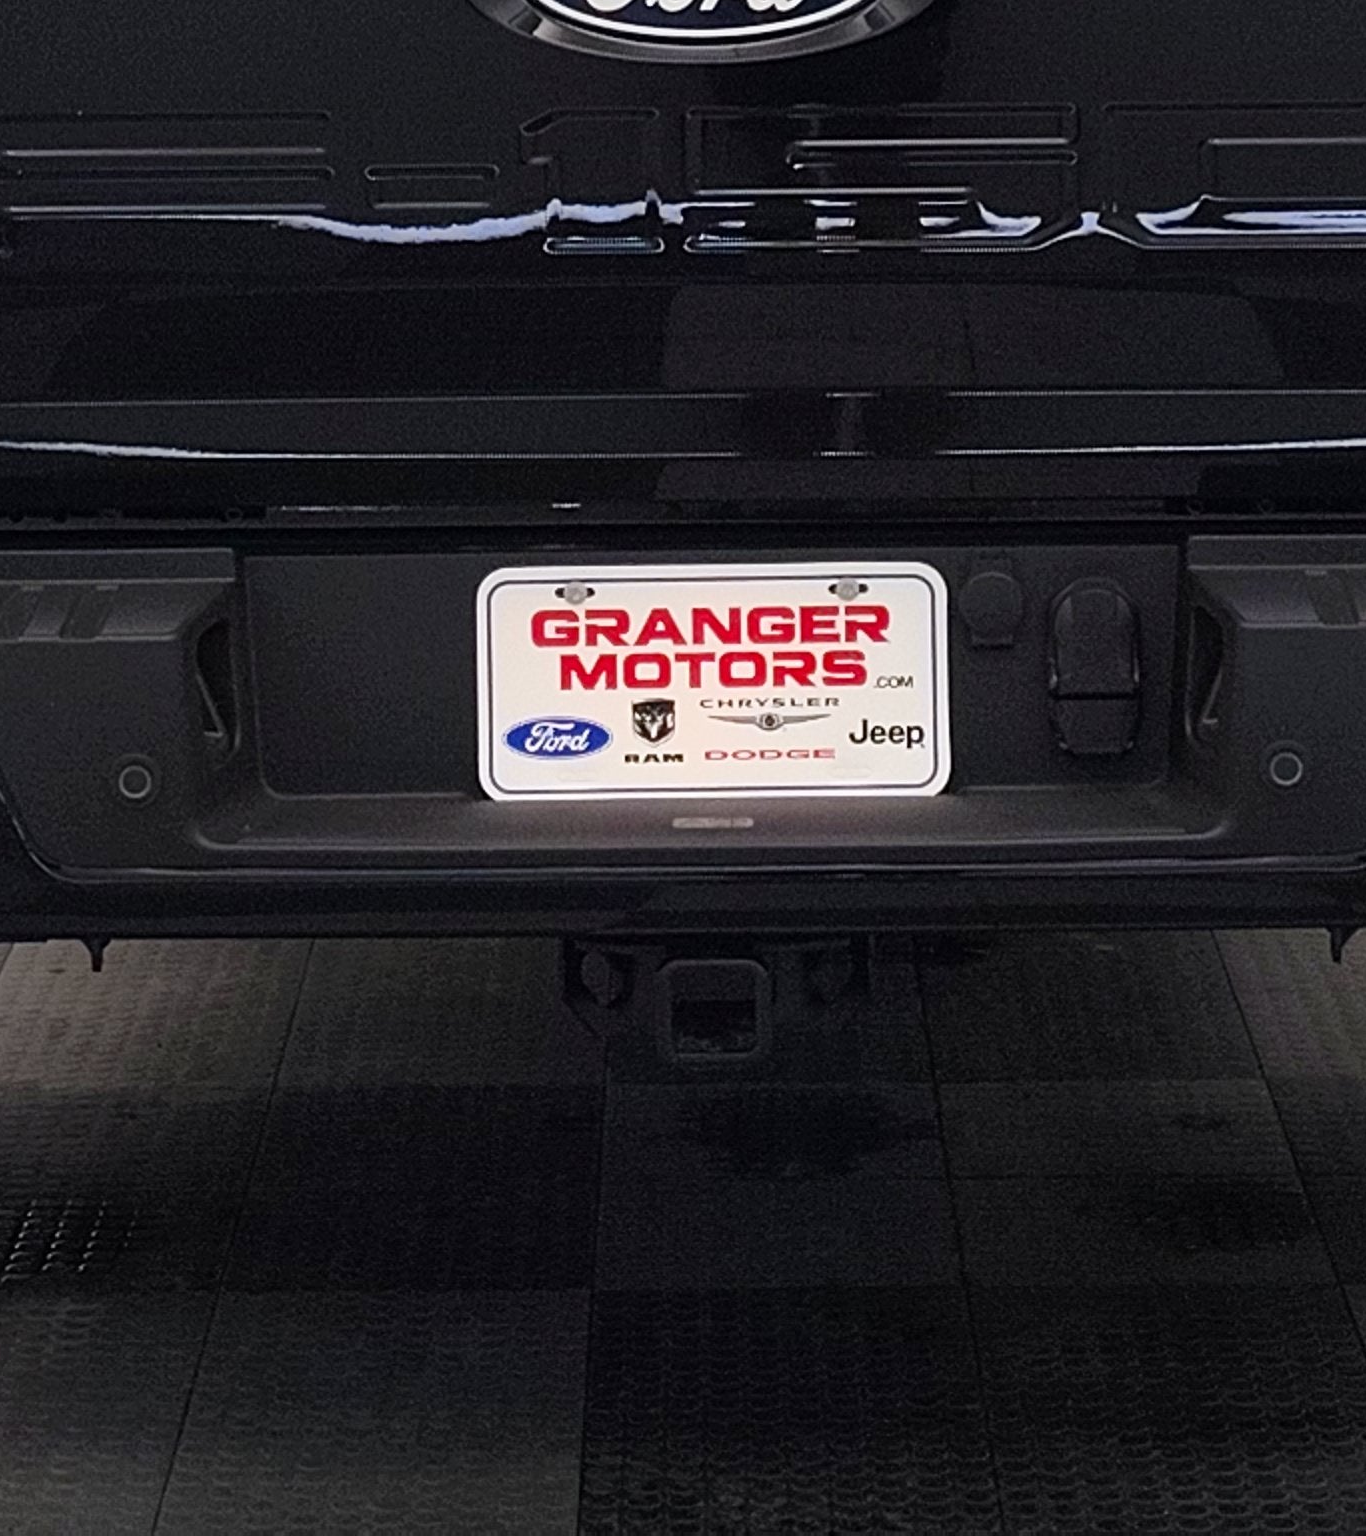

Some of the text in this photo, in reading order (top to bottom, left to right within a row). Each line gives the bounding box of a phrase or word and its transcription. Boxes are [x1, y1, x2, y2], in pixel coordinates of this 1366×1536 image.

[530, 605, 890, 648] GRANGER
[559, 650, 868, 690] MOTORS
[699, 697, 840, 709] CHRYSLER
[524, 719, 591, 755] Ford
[848, 719, 925, 749] Jeep
[624, 753, 684, 764] RAM
[703, 748, 836, 761] DODGE
